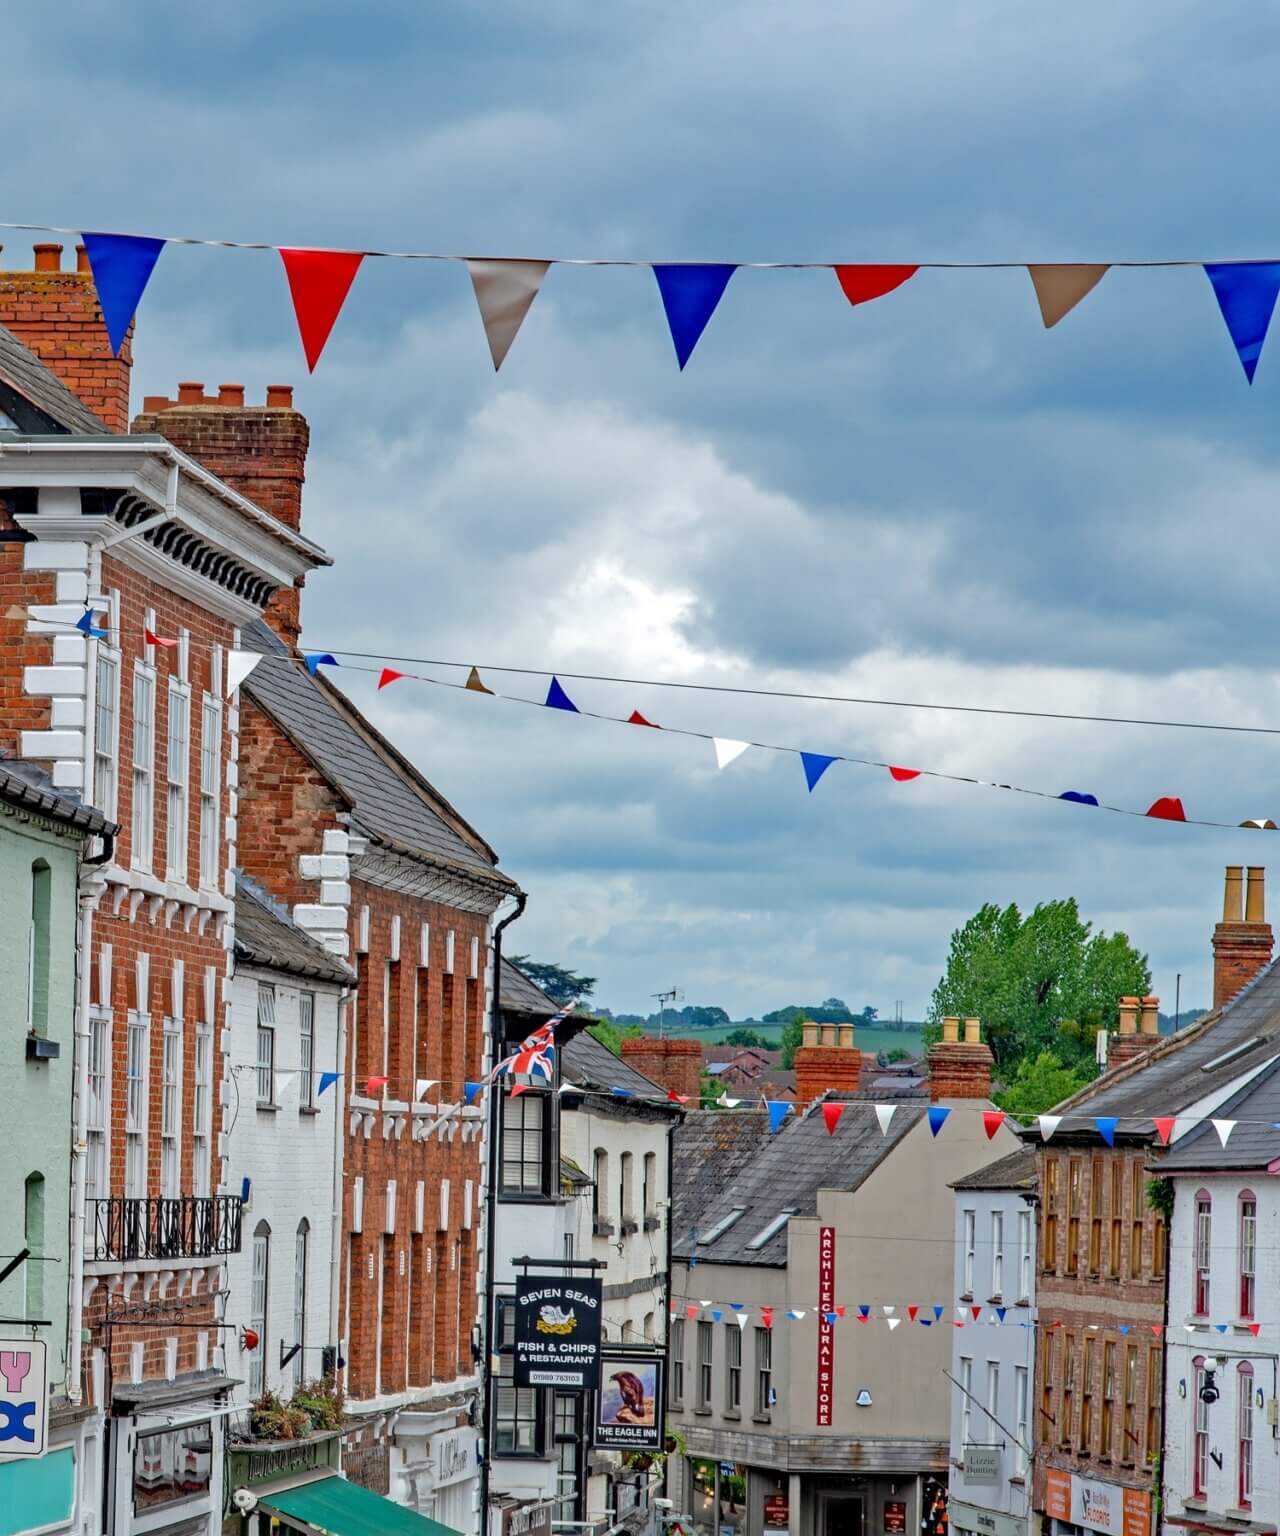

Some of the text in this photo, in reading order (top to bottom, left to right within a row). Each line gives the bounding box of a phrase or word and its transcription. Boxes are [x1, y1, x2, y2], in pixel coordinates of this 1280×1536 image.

[519, 1288, 598, 1308] SEVEN SEAS
[820, 1228, 831, 1424] ARCHITECTURAL STORE
[517, 1342, 597, 1354] FISH & CHIPS
[520, 1354, 594, 1364] & RESTAURANT
[597, 1426, 657, 1437] THE EAGLE INN
